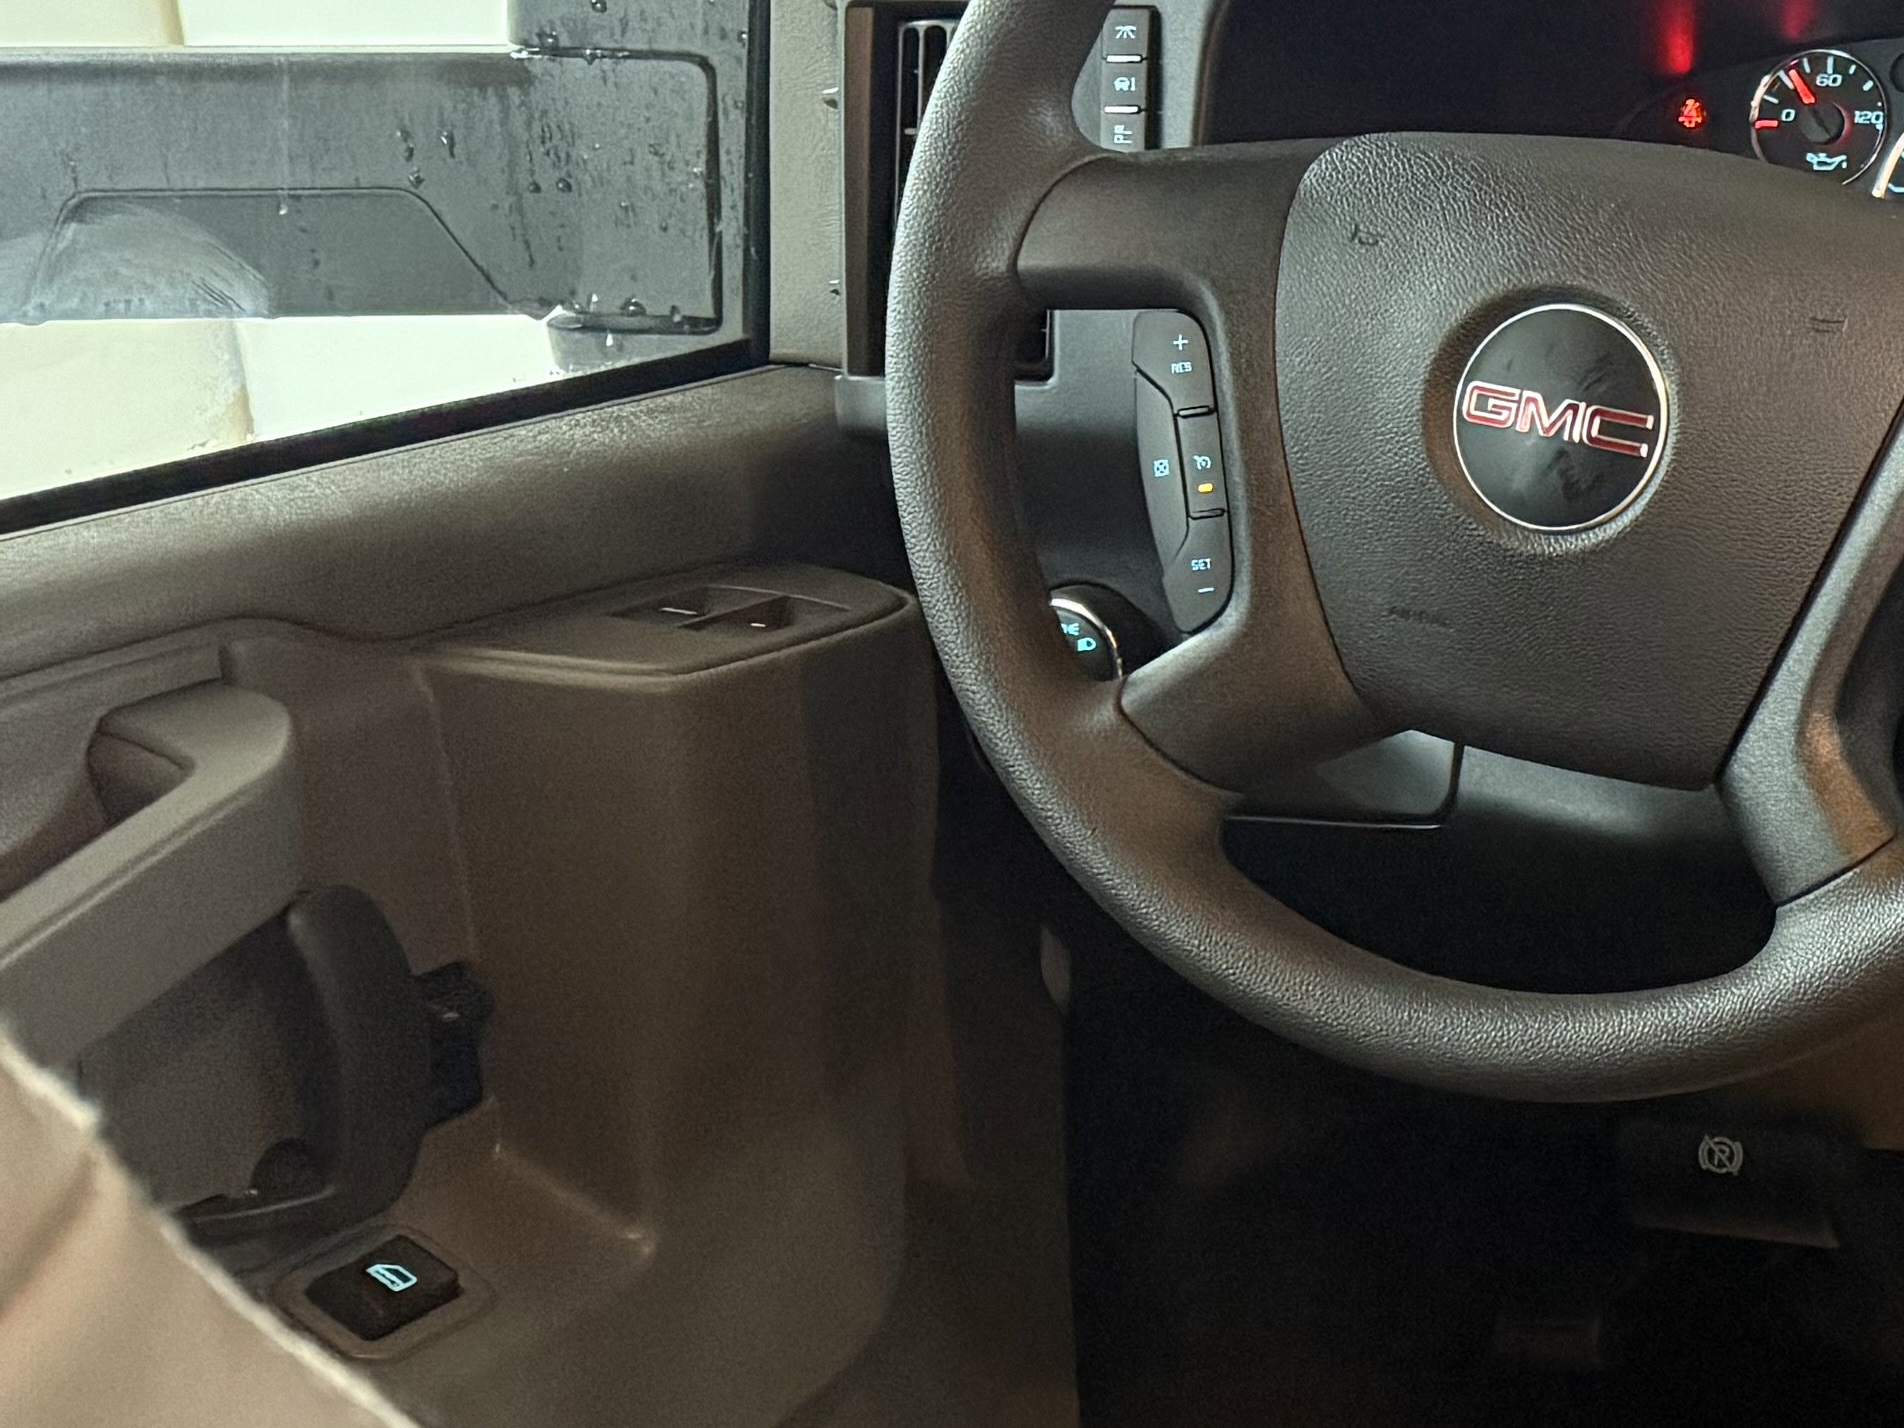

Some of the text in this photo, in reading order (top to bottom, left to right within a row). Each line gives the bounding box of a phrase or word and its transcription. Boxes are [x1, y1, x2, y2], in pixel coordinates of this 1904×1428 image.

[1815, 74, 1842, 87] 60
[1781, 109, 1795, 122] 0
[1854, 111, 1884, 124] 120
[1171, 361, 1192, 374] RES
[1462, 380, 1654, 458] GMC
[1191, 558, 1212, 571] SET
